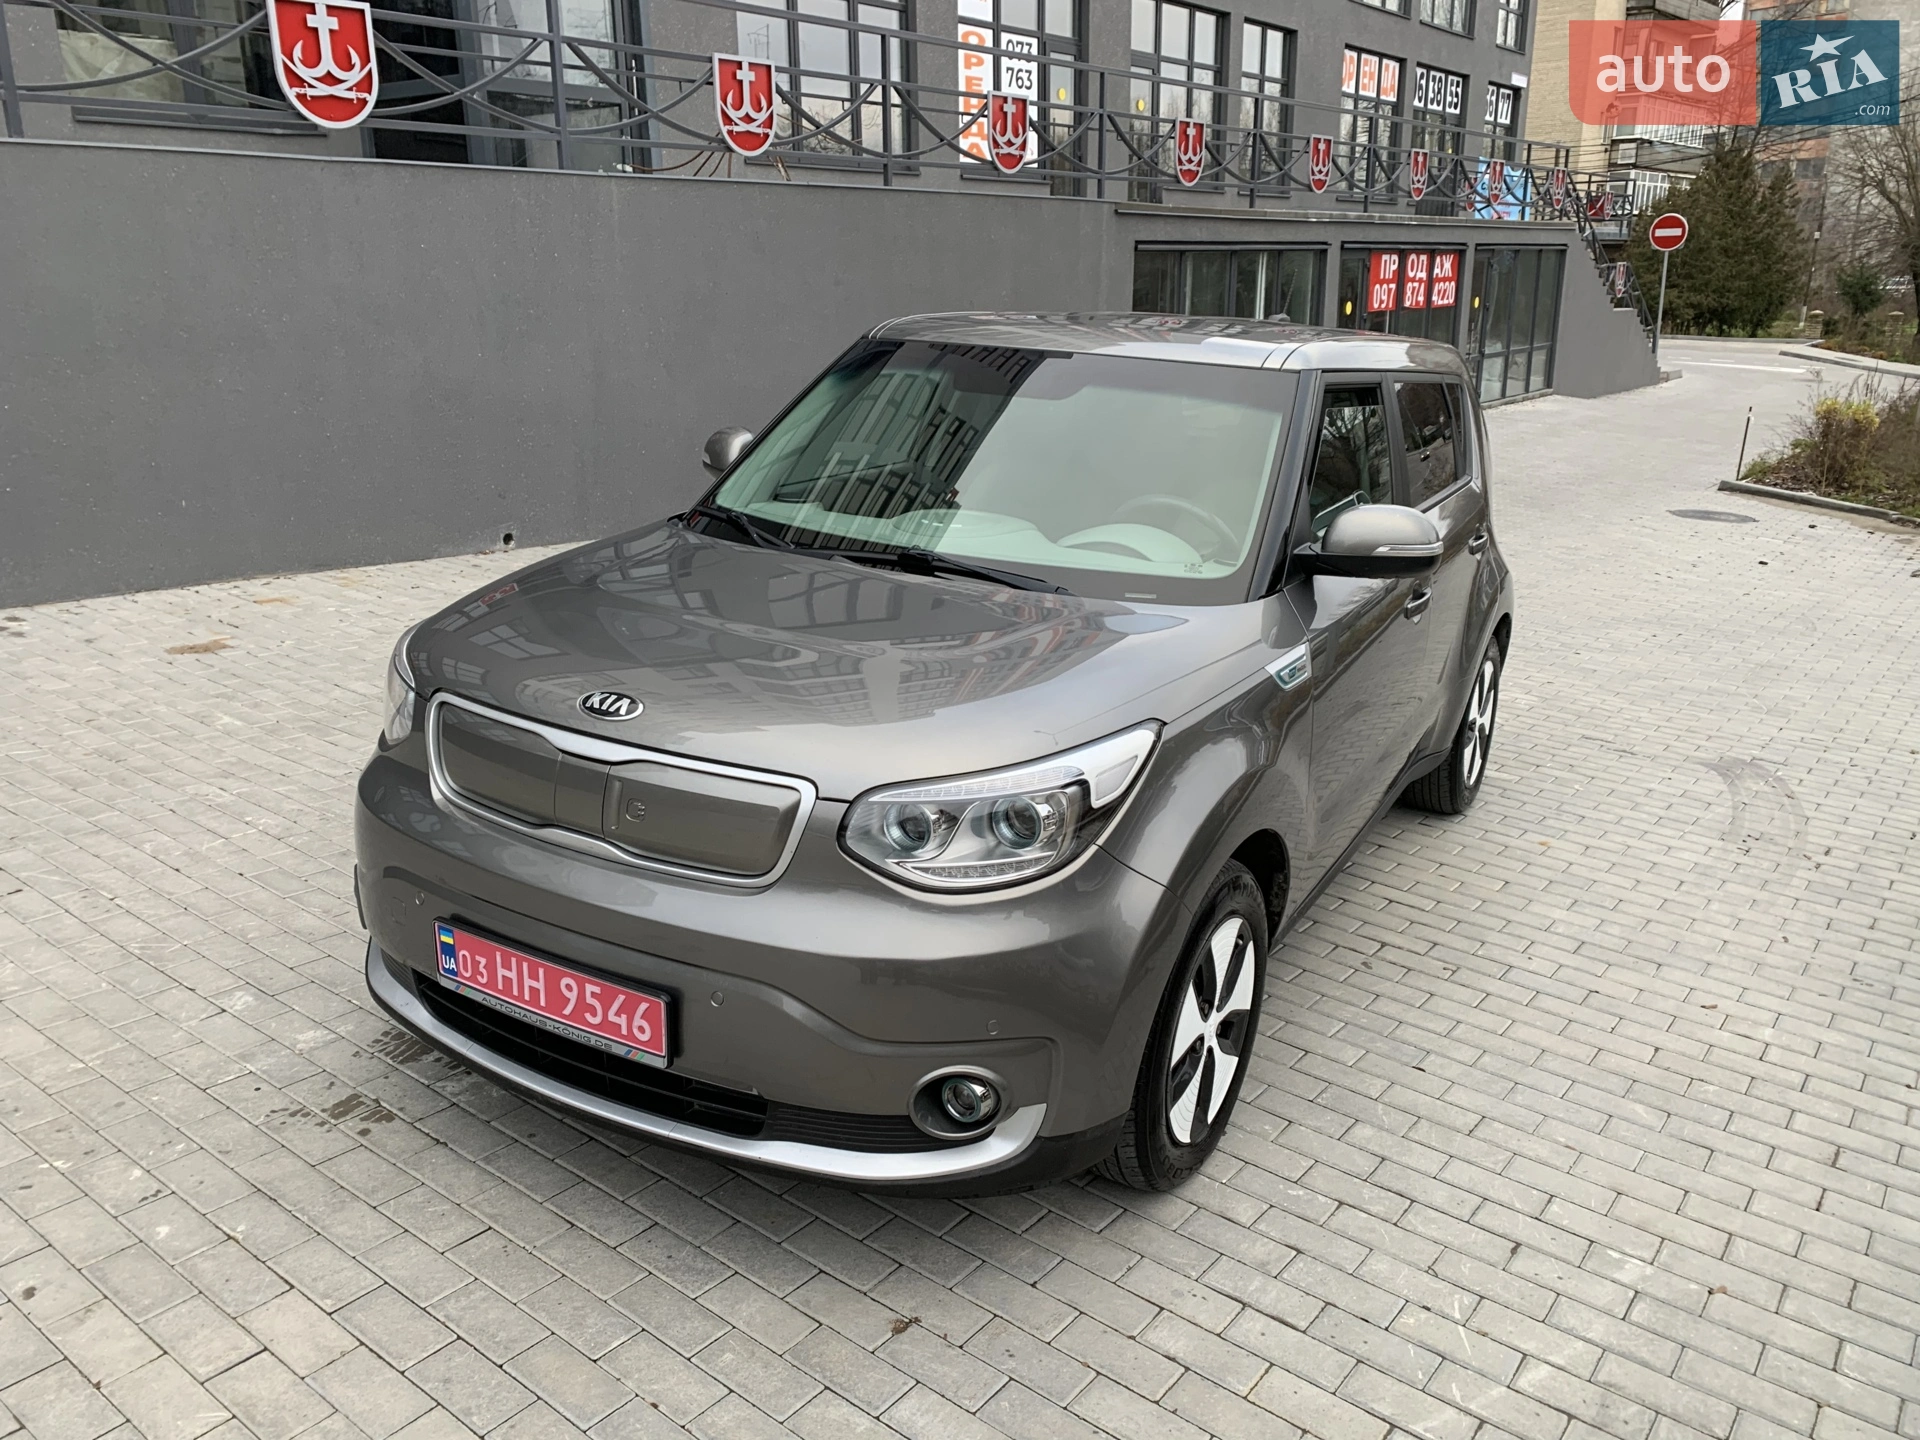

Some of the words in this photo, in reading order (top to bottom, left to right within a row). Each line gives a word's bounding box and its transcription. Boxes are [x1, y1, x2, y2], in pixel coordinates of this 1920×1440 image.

[1006, 67, 1033, 90] 763
[1429, 74, 1443, 107] 38
[1447, 79, 1460, 111] 55
[1373, 283, 1396, 309] 097
[1405, 281, 1425, 307] 874
[1432, 281, 1456, 306] 4220
[585, 691, 632, 716] KIA
[442, 954, 457, 972] UA
[459, 949, 488, 984] 03
[496, 951, 546, 1007] HH
[560, 976, 652, 1042] 9546
